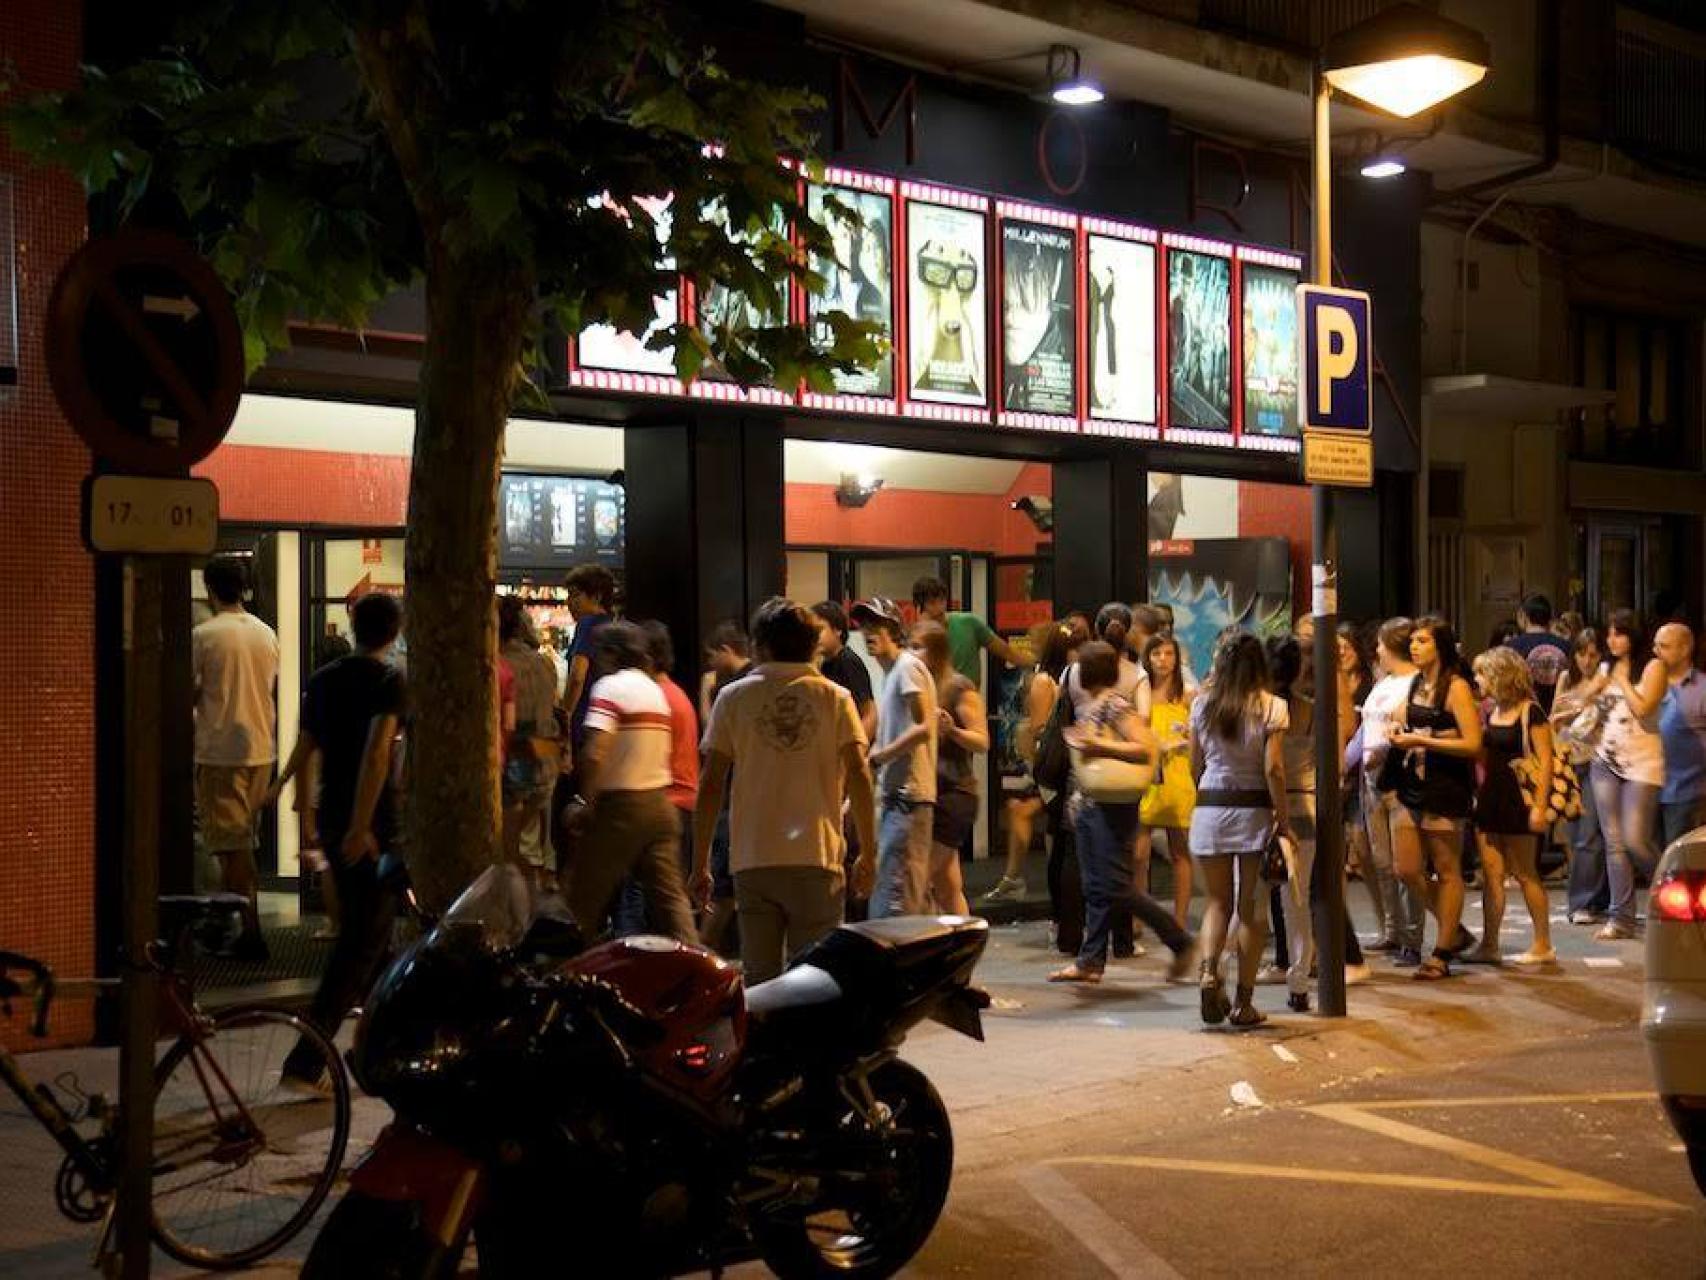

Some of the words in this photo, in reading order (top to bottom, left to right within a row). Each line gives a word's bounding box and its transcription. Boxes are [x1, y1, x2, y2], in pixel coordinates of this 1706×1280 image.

[1316, 303, 1358, 415] P
[108, 501, 131, 526] 17
[171, 504, 192, 528] 01
